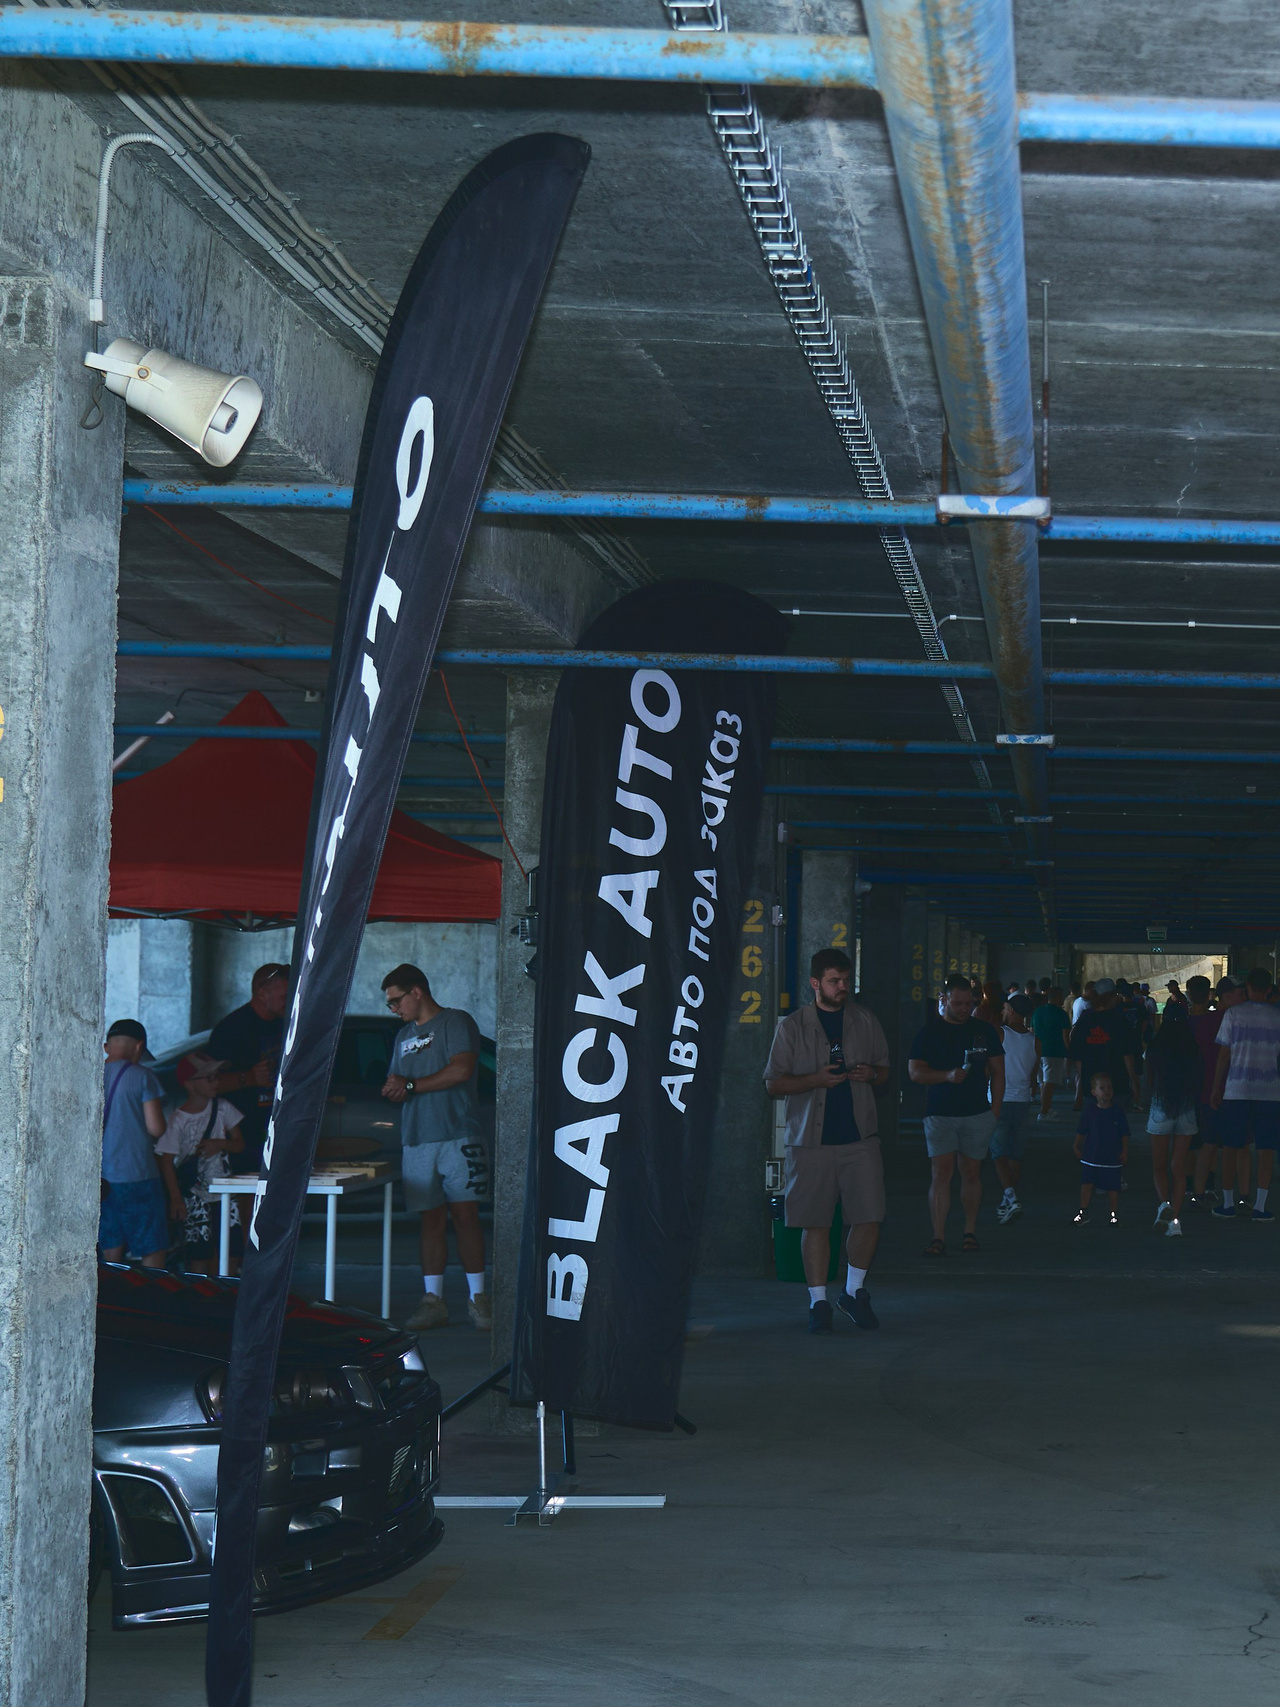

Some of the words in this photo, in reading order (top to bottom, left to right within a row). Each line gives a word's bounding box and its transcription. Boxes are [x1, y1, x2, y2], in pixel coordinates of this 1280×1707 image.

[546, 950, 646, 1321] BLACK
[598, 668, 682, 939] AUTO
[739, 900, 764, 1024] 262
[460, 1143, 489, 1196] GAP
